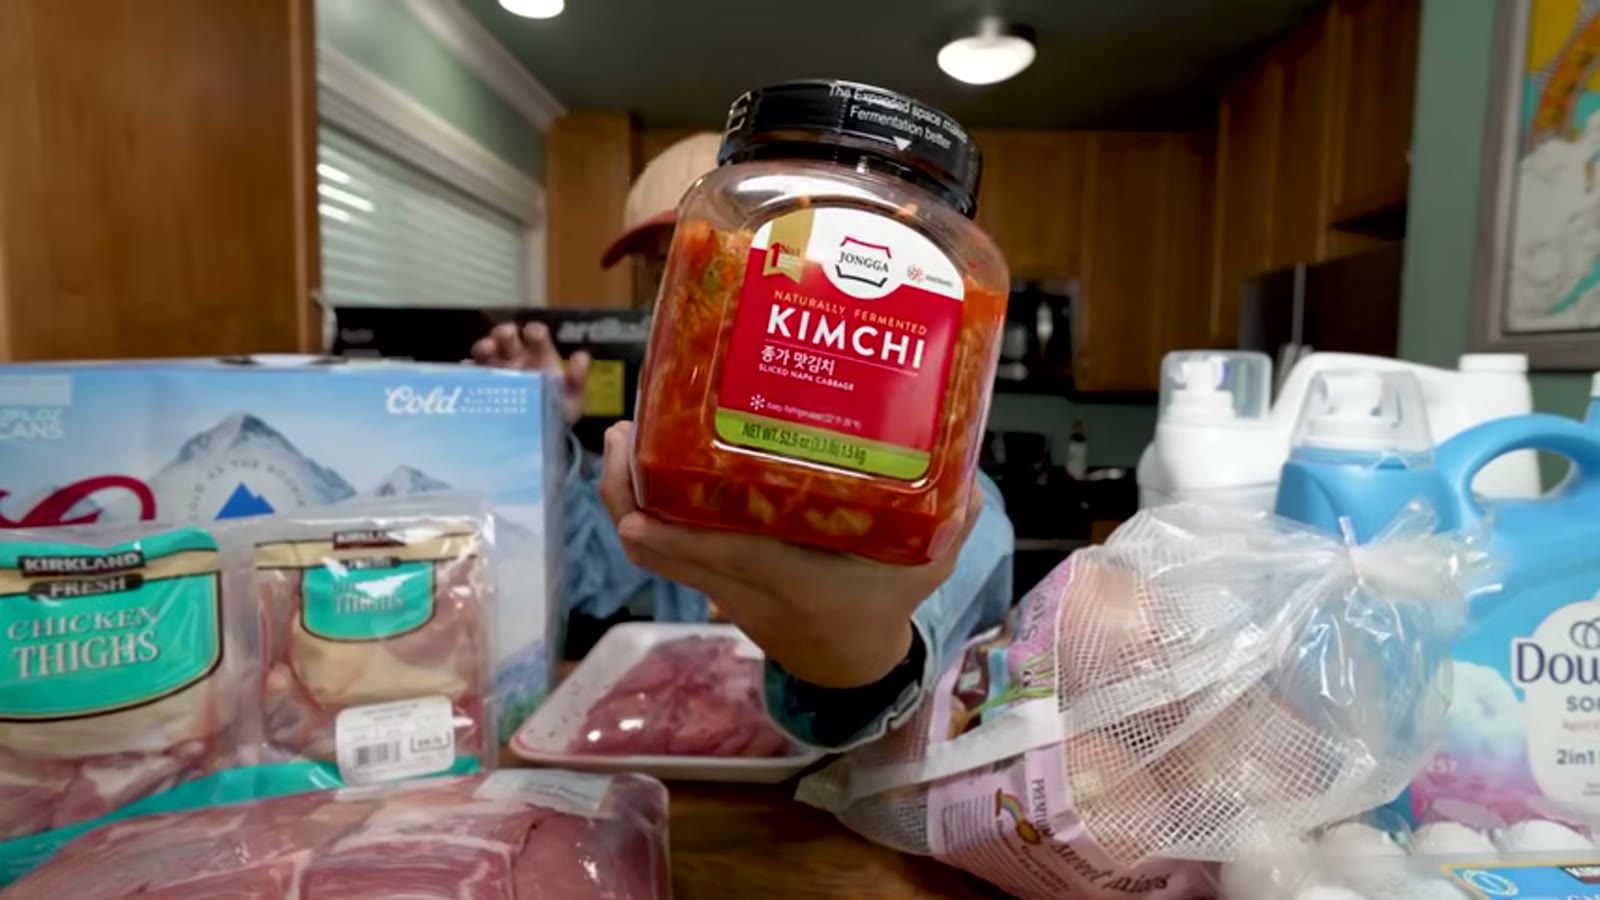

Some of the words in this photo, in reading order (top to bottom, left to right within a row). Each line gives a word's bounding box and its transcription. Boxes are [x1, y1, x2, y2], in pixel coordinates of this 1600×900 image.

[829, 82, 851, 98] The
[911, 105, 942, 127] space
[849, 104, 924, 137] Fermentation
[924, 126, 951, 149] better
[839, 250, 889, 273] JONGGA
[774, 289, 847, 316] NATURALLY
[854, 308, 927, 336] FERMENTED
[767, 304, 925, 368] KIMCHI
[761, 345, 790, 366] 종가
[793, 351, 835, 376] 맛김치
[758, 362, 789, 377] SLICED
[790, 370, 814, 382] NAPA
[815, 376, 854, 392] CABBAGE
[384, 384, 462, 415] Cold
[741, 421, 761, 440] NET
[23, 552, 140, 571] KIRKLAND
[50, 577, 126, 596] FRESH
[7, 607, 156, 641] CHICKEN
[12, 630, 161, 678] THIGHS
[1556, 748, 1595, 766] 2in1
[1031, 778, 1056, 838] PREMIUM
